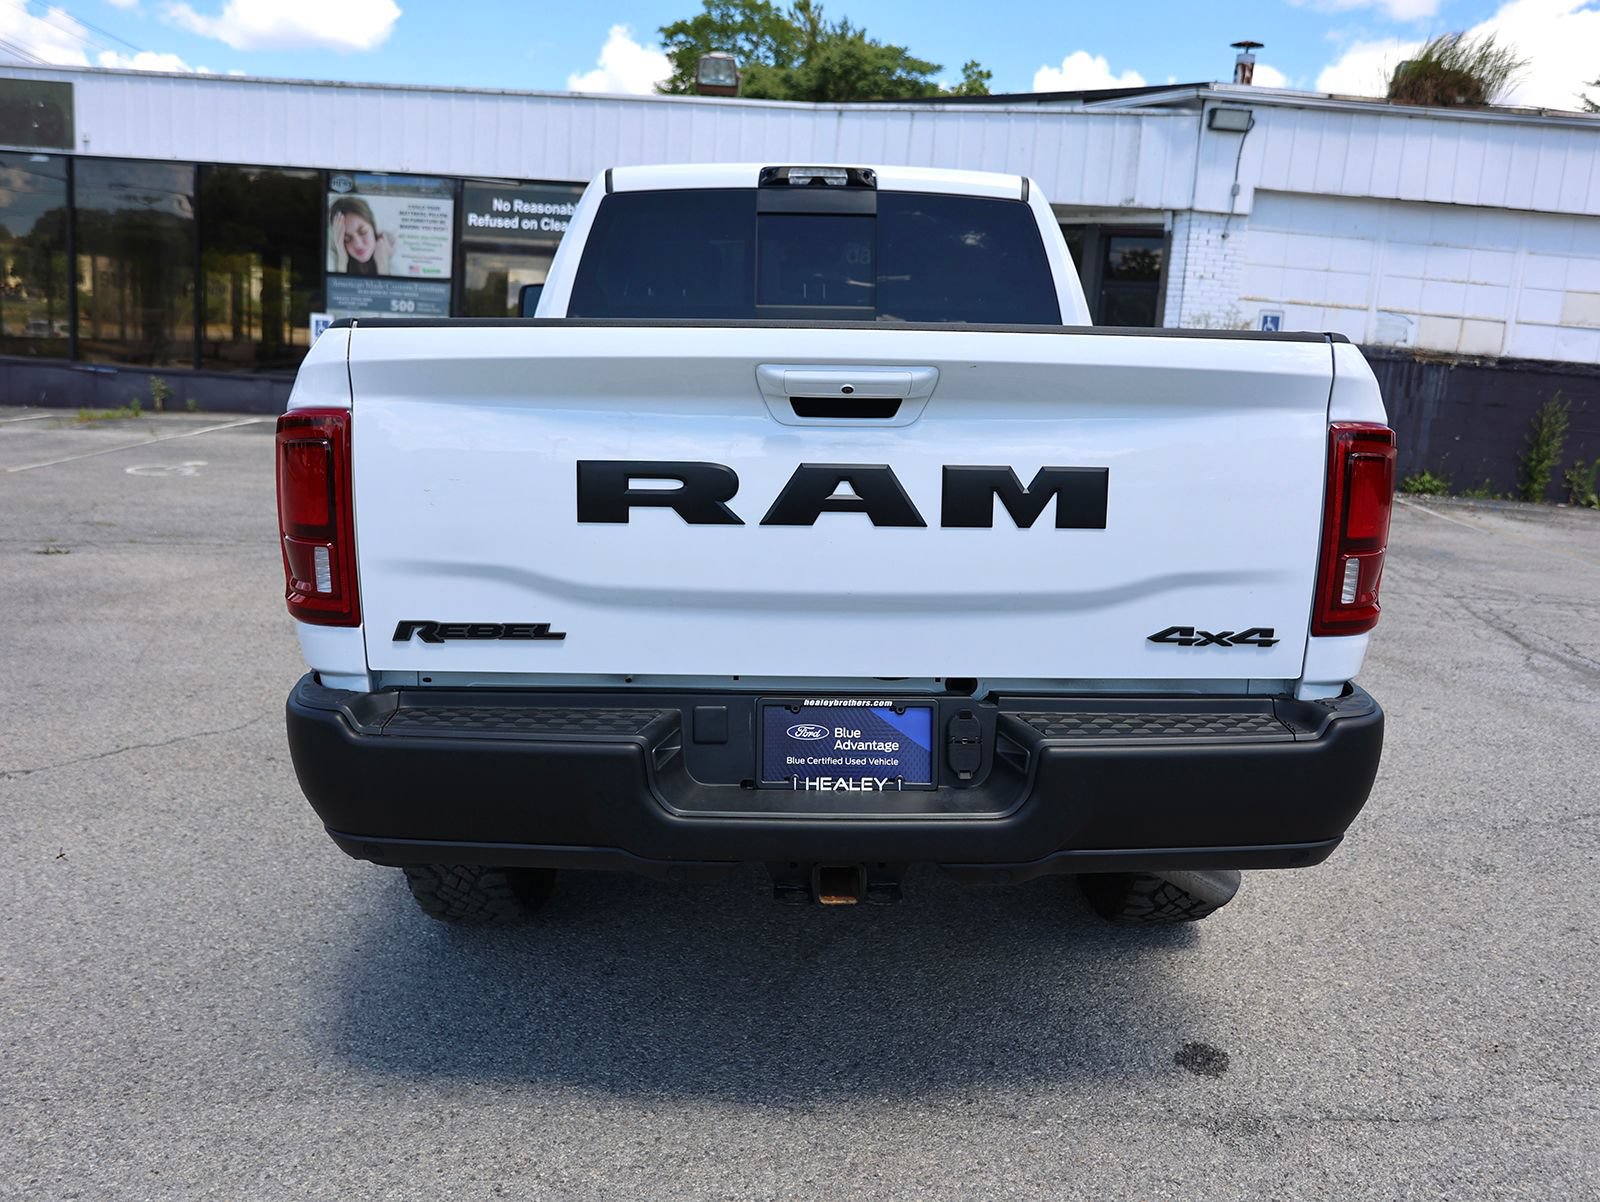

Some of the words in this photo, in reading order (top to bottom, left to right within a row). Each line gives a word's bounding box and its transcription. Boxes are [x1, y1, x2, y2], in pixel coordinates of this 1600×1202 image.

[492, 198, 511, 212] No
[513, 199, 578, 216] Reasonab
[467, 213, 519, 229] Refused
[521, 219, 538, 231] on
[540, 218, 568, 232] Clea
[390, 299, 416, 313] 500
[576, 459, 1109, 529] RAM
[392, 620, 567, 643] REBEL
[1146, 626, 1280, 647] 4x4
[803, 699, 893, 708] healeybrothers.com
[794, 726, 821, 738] Ford
[834, 727, 861, 738] Blue
[834, 740, 899, 753] Advantage
[786, 756, 805, 765] Blue
[807, 757, 843, 765] Certified
[845, 758, 867, 766] Used
[868, 758, 899, 766] Vehicle
[805, 777, 888, 791] HEALEY
